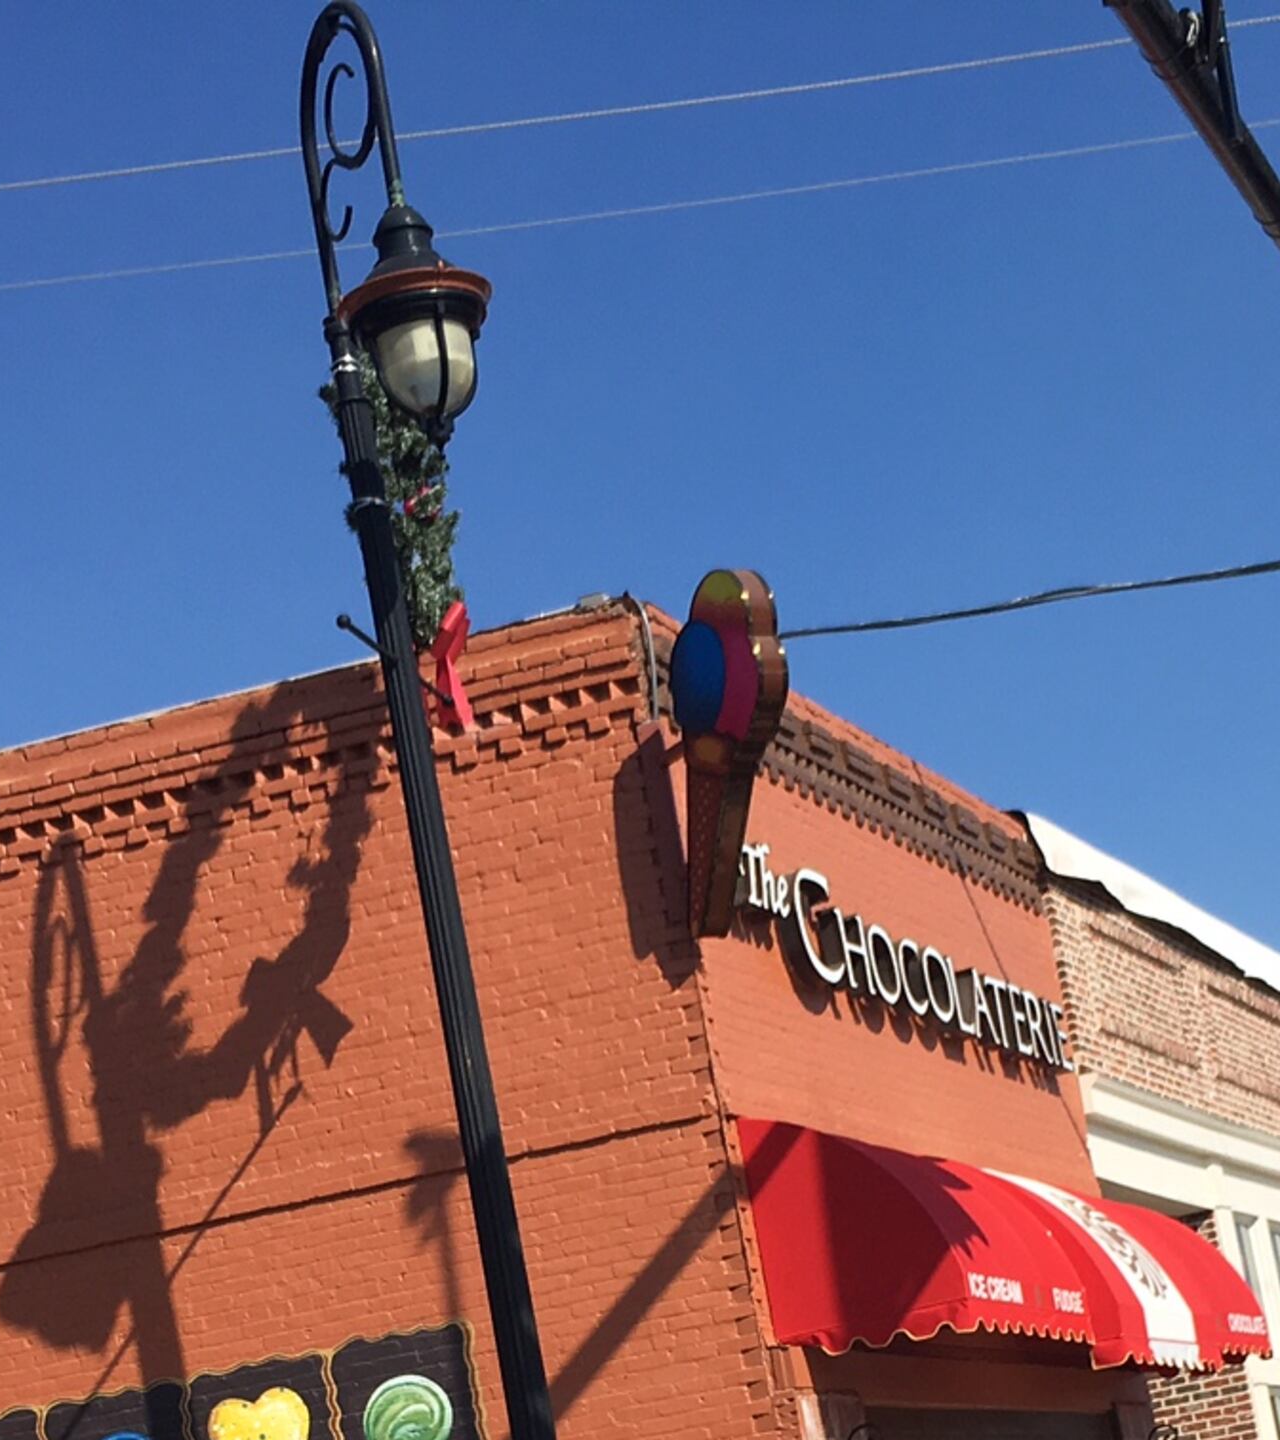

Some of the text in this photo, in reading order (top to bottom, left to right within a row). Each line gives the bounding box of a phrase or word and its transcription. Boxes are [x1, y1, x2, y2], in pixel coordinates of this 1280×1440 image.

[738, 843, 1074, 1072] The CHOCOLATERIE
[967, 1271, 1024, 1305] ICE CREAM
[1051, 1287, 1085, 1315] FUDGE
